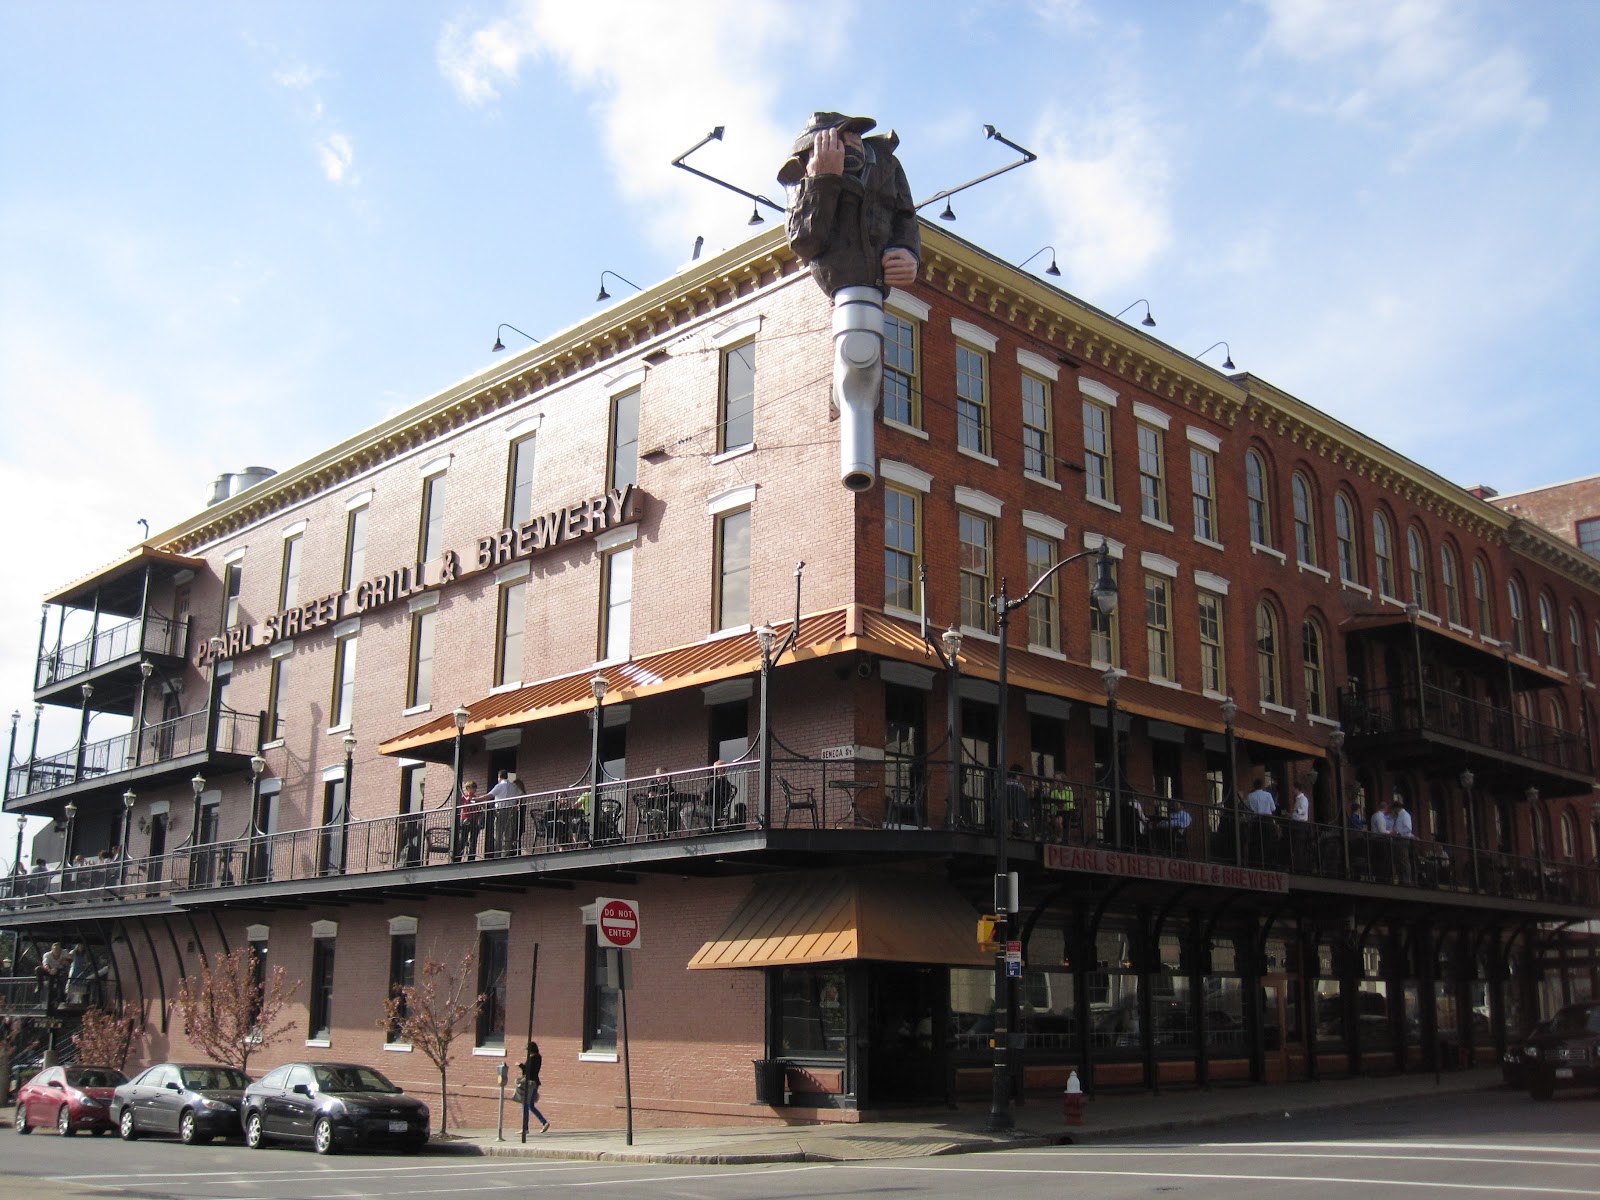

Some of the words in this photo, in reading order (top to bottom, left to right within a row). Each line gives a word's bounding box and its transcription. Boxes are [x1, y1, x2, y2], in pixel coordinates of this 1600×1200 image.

[262, 589, 348, 645] STREET
[355, 562, 427, 612] GRILL
[439, 549, 459, 584] &
[476, 483, 634, 571] BREWERY
[822, 749, 843, 759] SENECA
[1048, 846, 1101, 870] PEARL
[1106, 856, 1167, 878] STREET
[1168, 862, 1210, 881] GRILL
[1210, 868, 1221, 883] &
[1223, 869, 1284, 890] BREWERY
[604, 909, 615, 917] DO
[618, 910, 633, 918] NOT
[608, 929, 631, 937] ENTER
